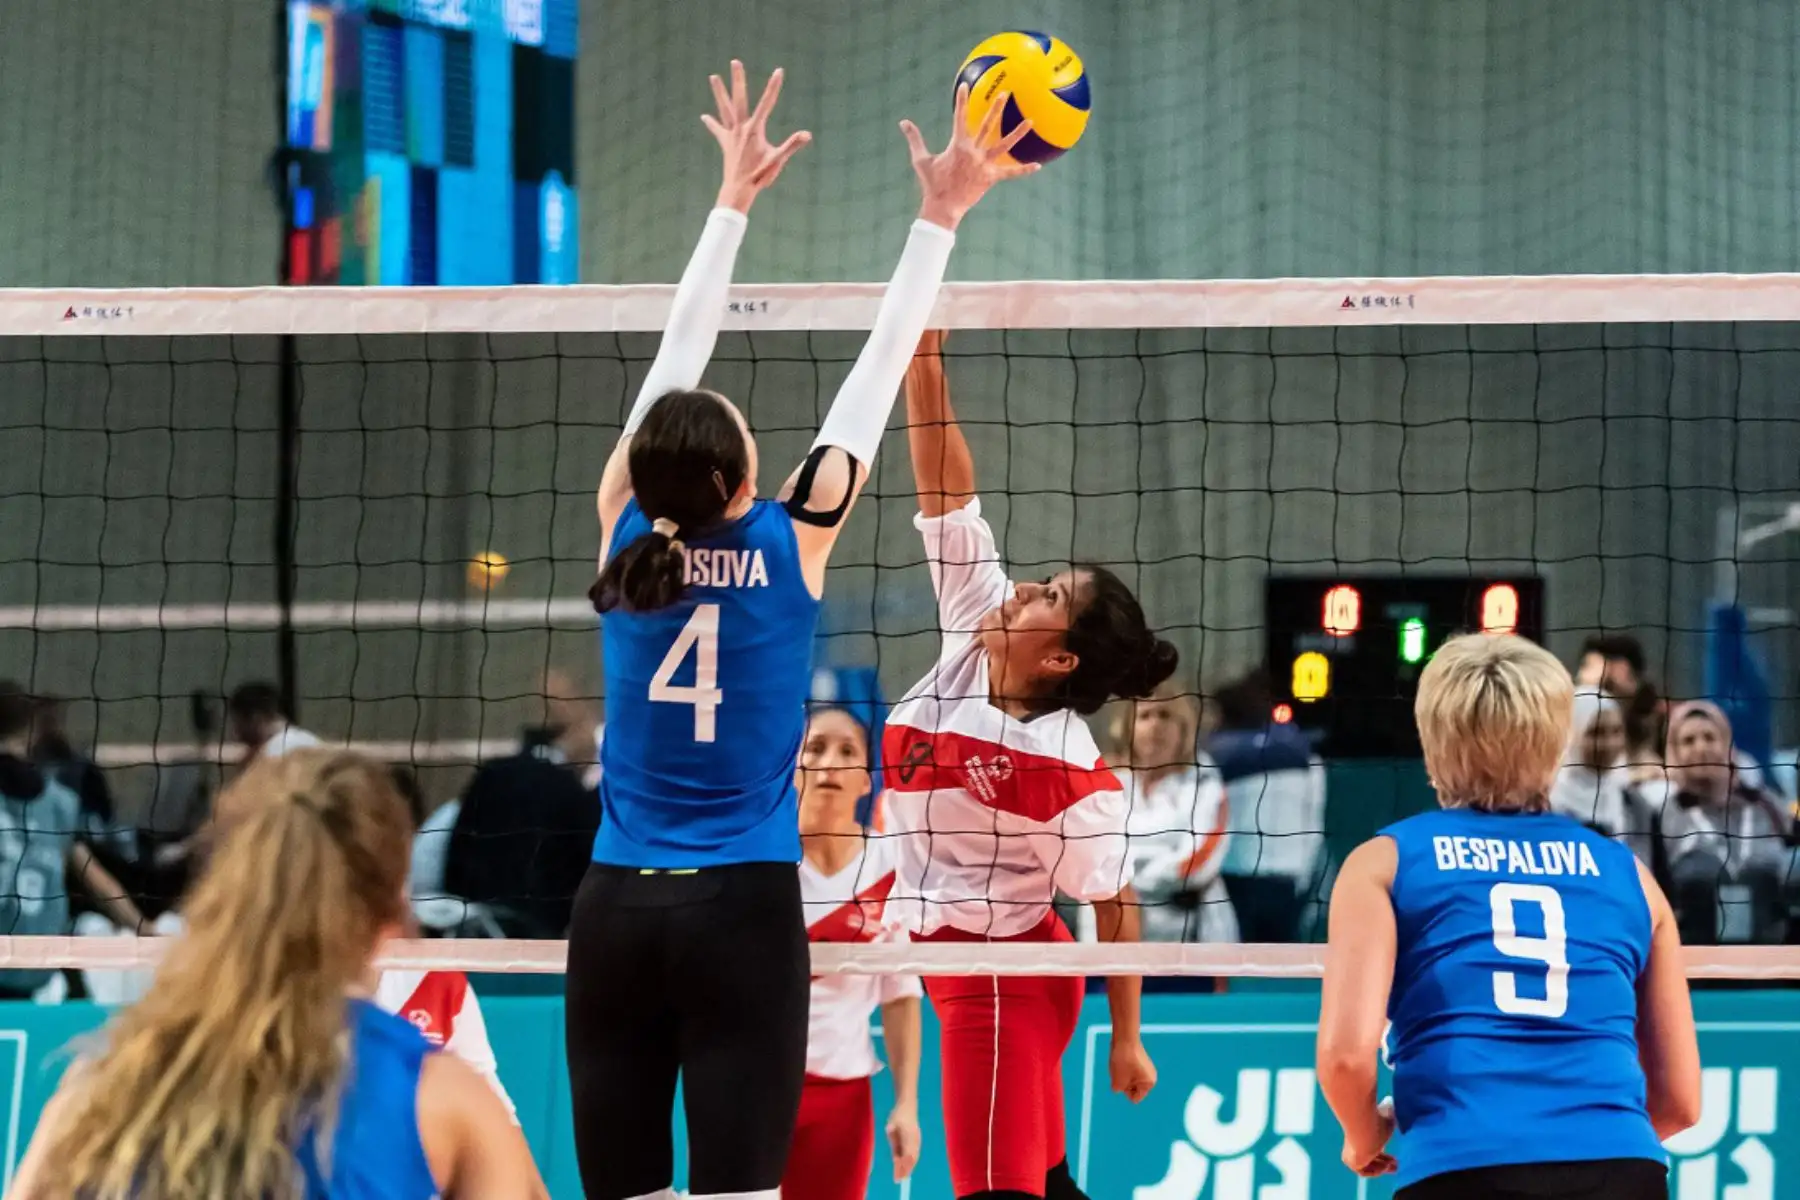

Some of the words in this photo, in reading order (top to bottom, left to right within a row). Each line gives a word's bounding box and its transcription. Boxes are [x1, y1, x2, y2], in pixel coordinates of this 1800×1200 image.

[648, 603, 723, 743] 4
[1433, 835, 1600, 877] BESPALOVA
[1489, 882, 1571, 1019] 9
